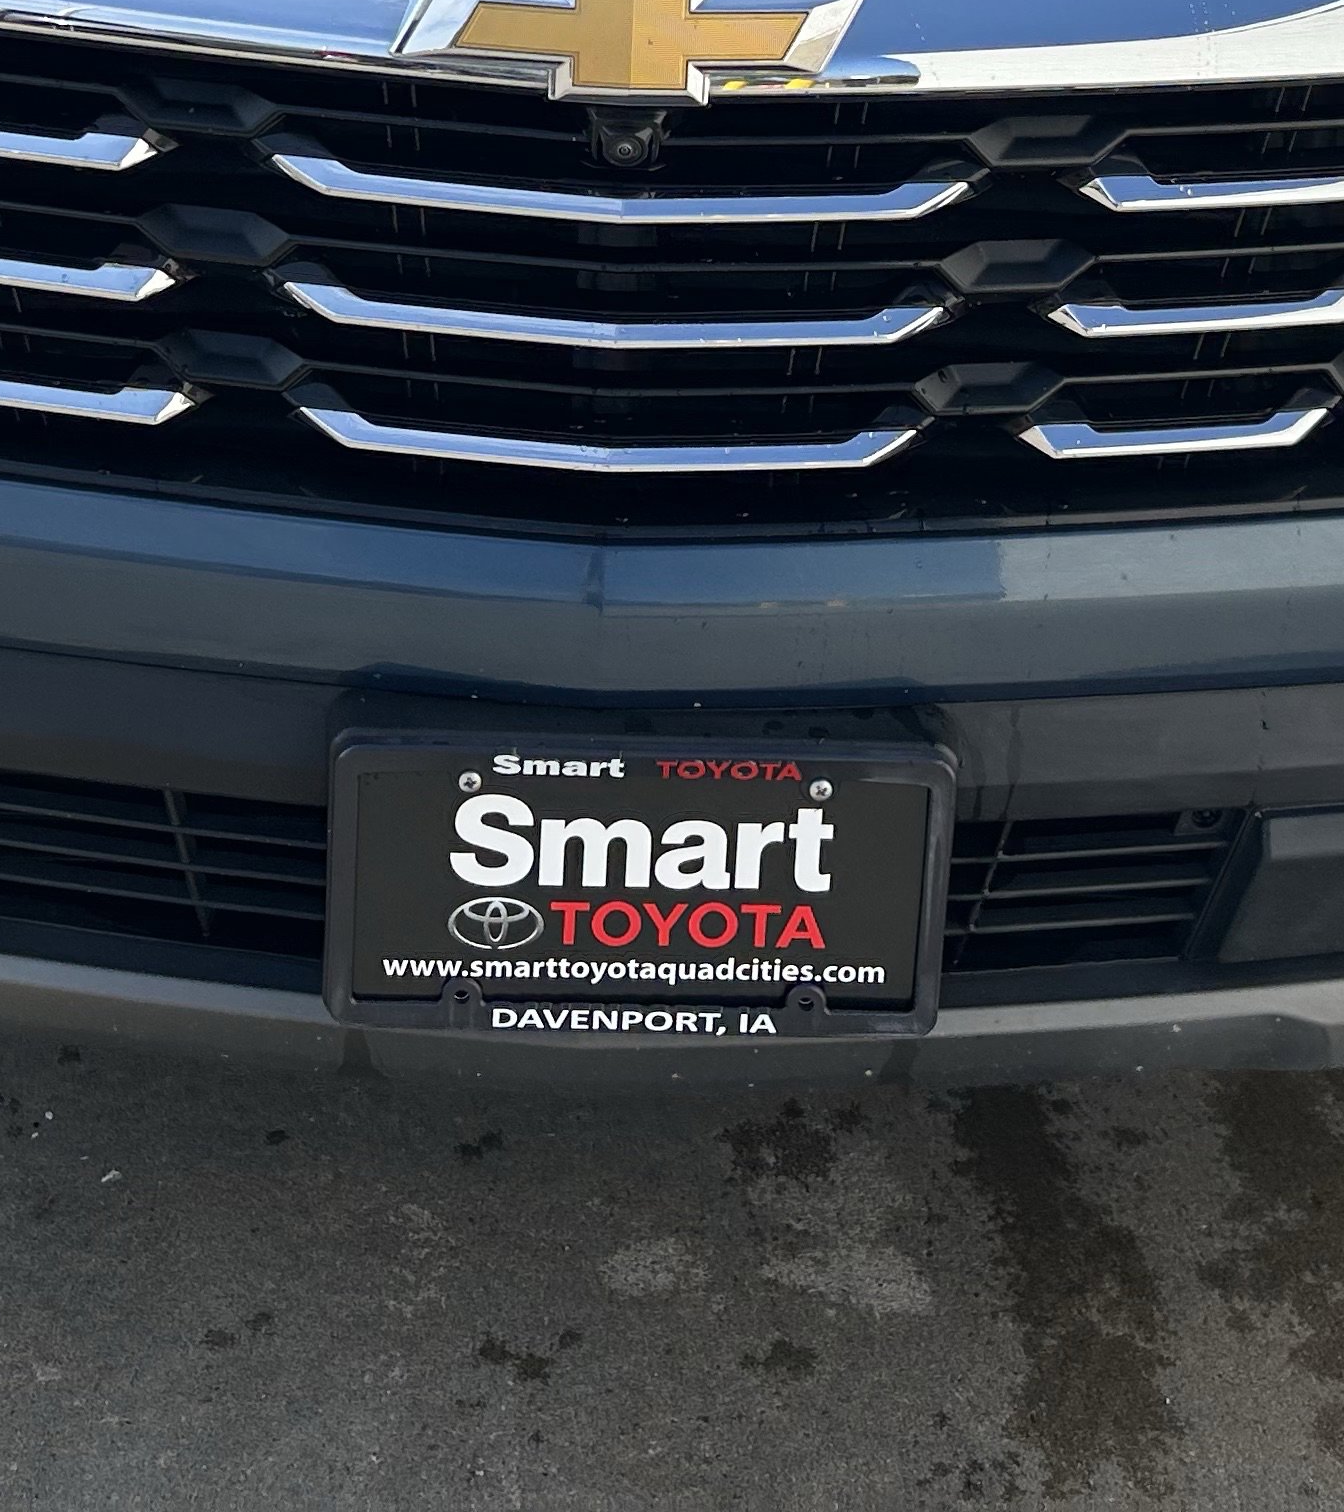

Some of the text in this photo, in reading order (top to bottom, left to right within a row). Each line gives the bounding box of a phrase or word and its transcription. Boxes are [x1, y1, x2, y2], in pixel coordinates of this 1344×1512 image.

[492, 753, 803, 782] Smart TOYOTA
[449, 793, 835, 893] Smart
[550, 900, 826, 949] TOYOTA
[381, 956, 886, 985] www.smarttoyotaquadcities.com
[491, 1007, 778, 1037] DAVENPORT, IA
